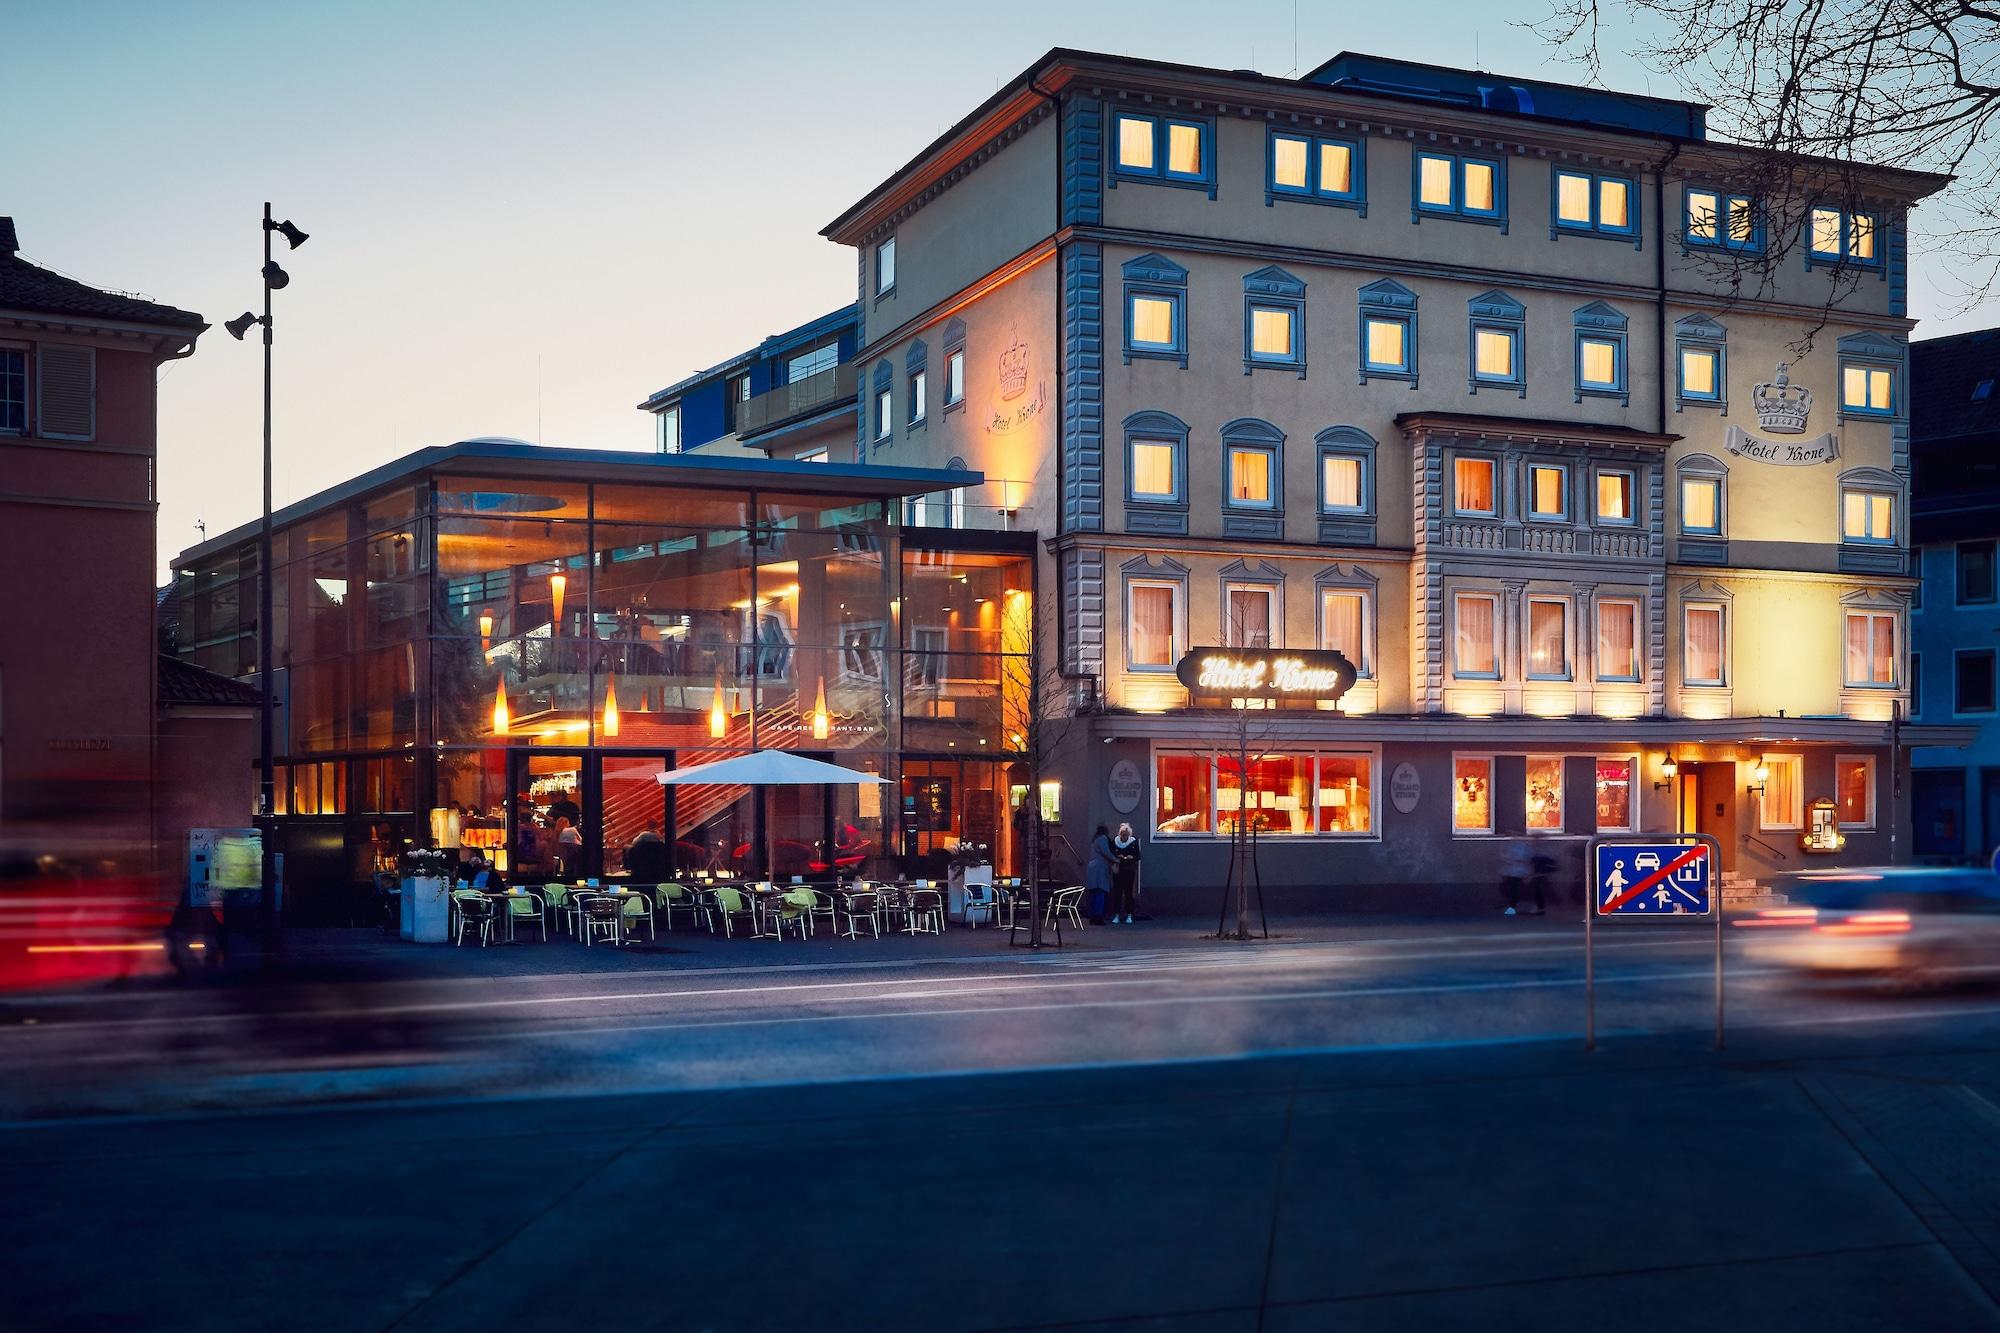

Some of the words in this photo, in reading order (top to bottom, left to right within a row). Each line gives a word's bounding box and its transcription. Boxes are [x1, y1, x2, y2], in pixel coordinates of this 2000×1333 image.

[991, 411, 1011, 431] Hotel
[1016, 399, 1038, 426] Krone
[1740, 437, 1780, 461] Hotel
[1785, 444, 1826, 462] Krone
[1198, 656, 1267, 690] Hotel
[1268, 658, 1338, 691] Krone
